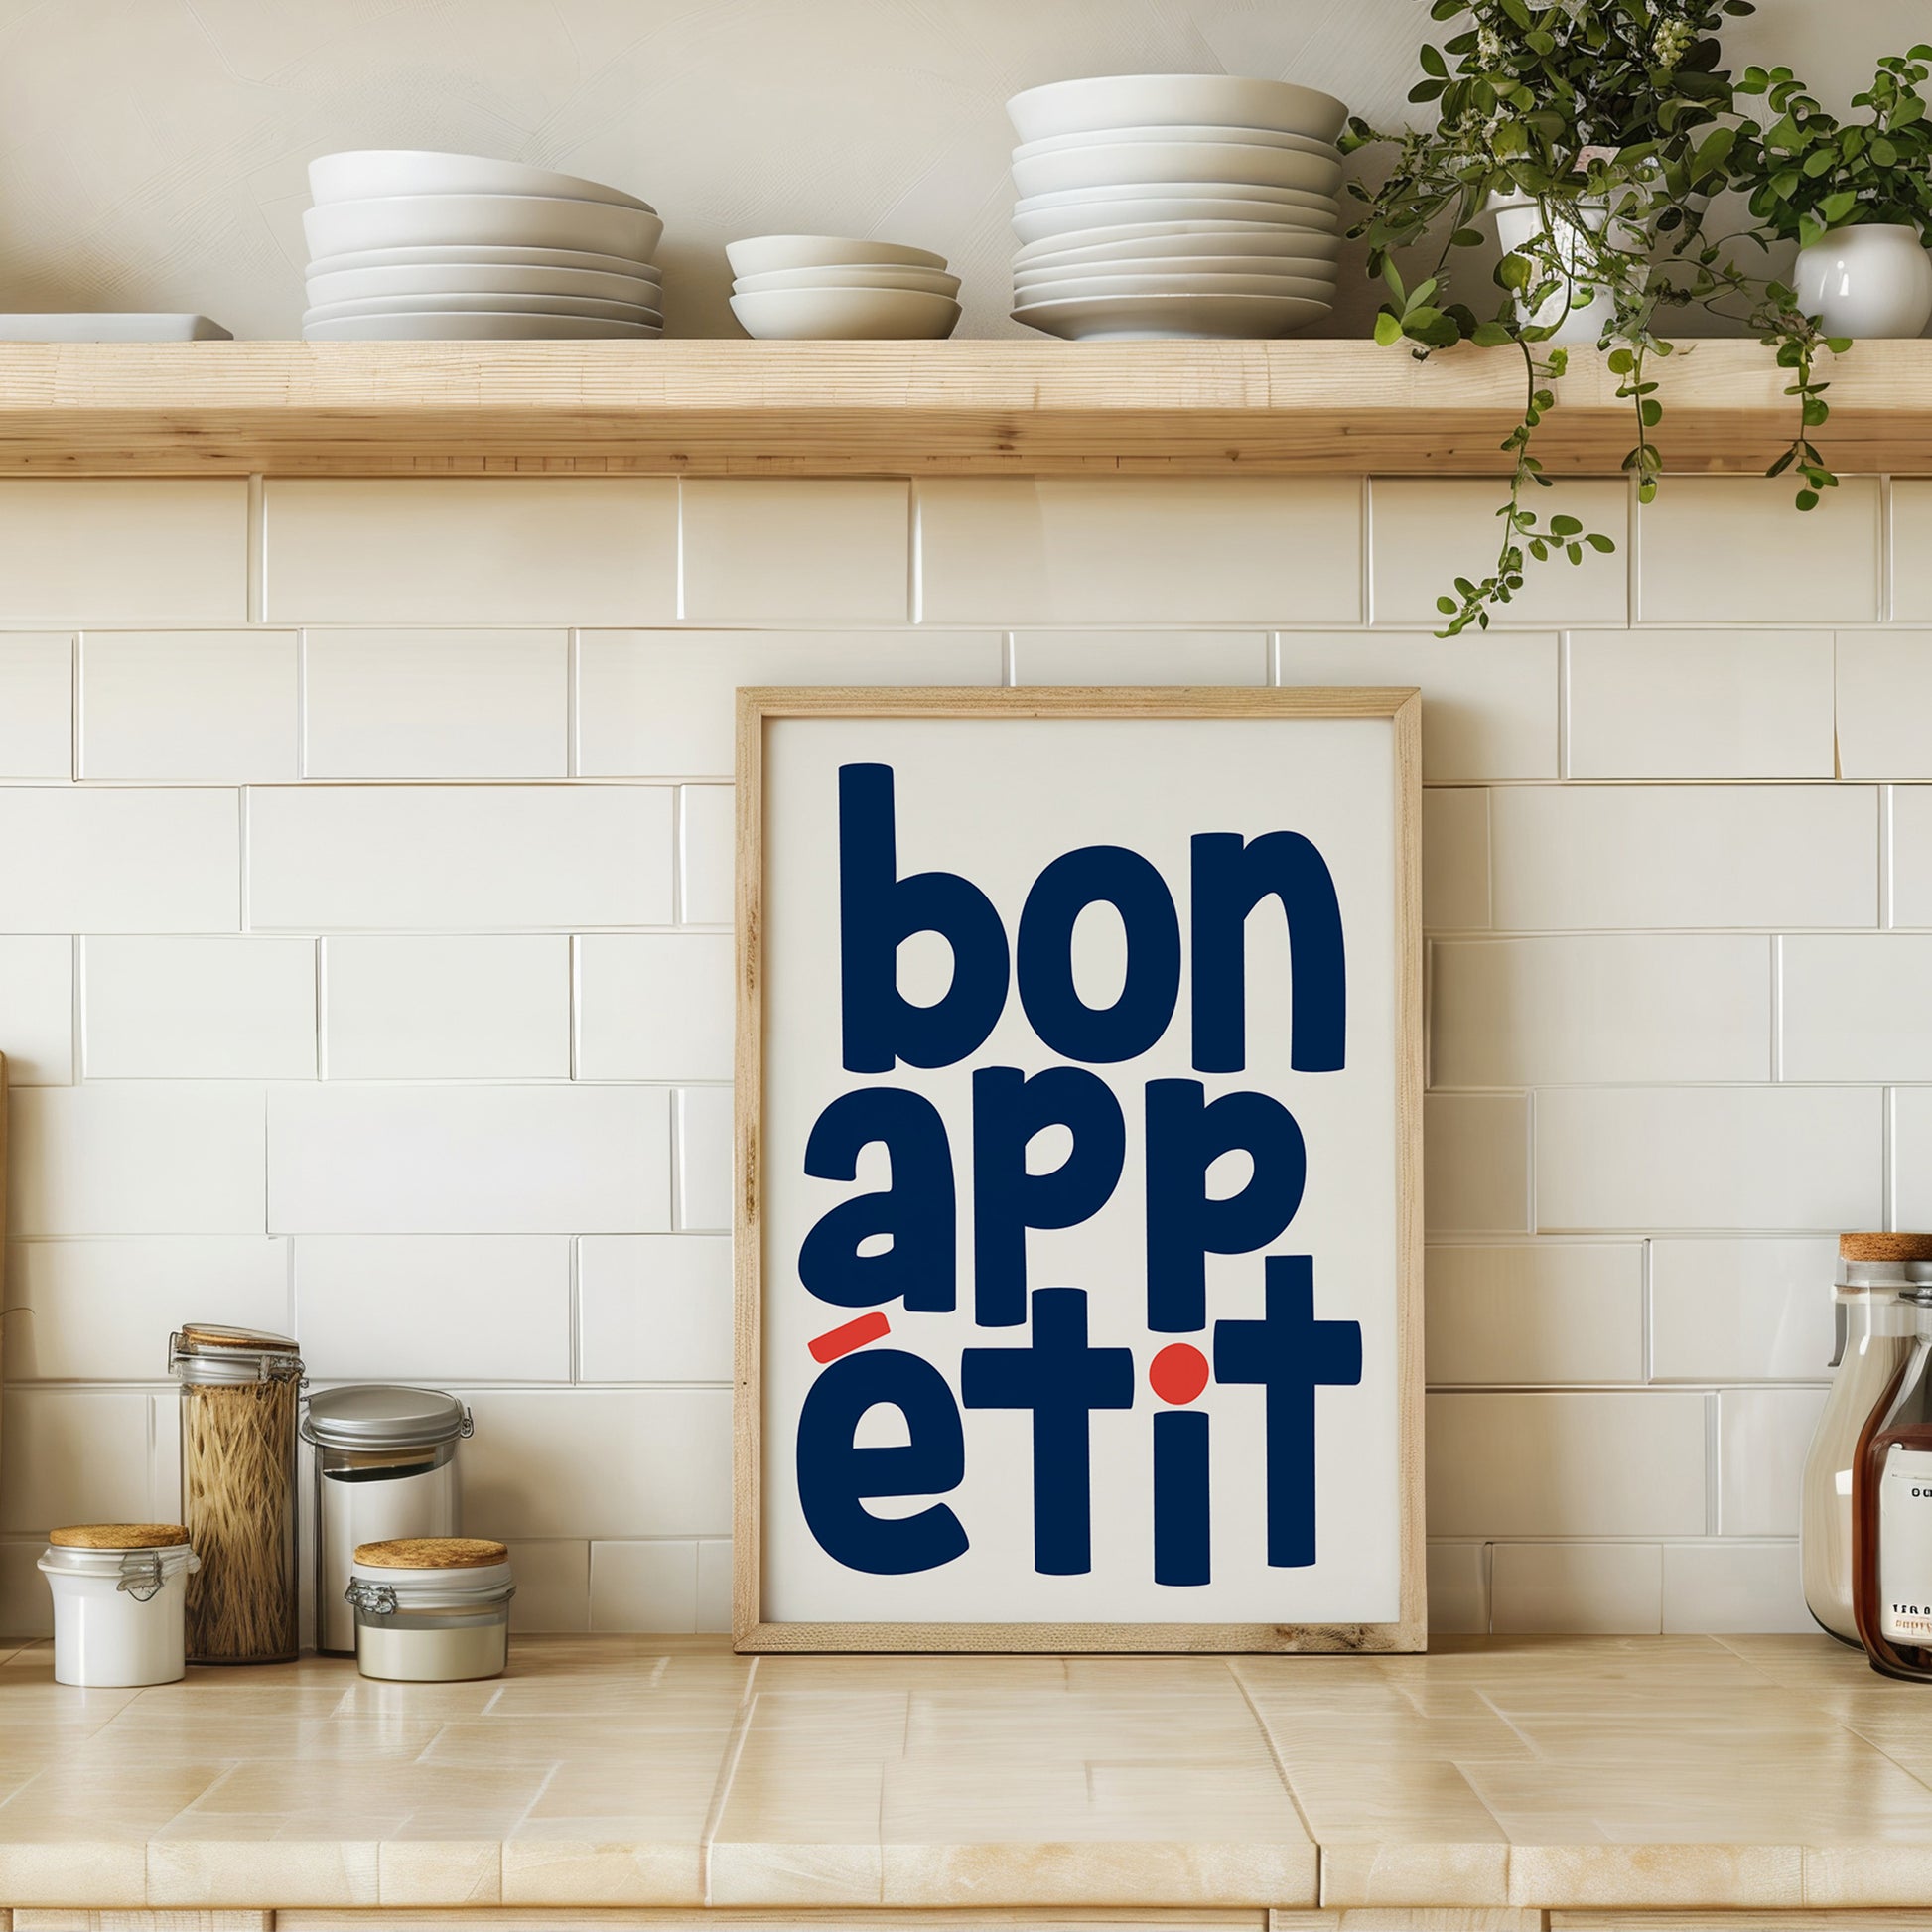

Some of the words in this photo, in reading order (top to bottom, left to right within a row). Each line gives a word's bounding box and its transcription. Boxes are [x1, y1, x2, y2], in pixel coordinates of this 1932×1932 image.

[839, 763, 1346, 1073] bon
[798, 1067, 1306, 1333] app
[796, 1255, 1363, 1587] étit
